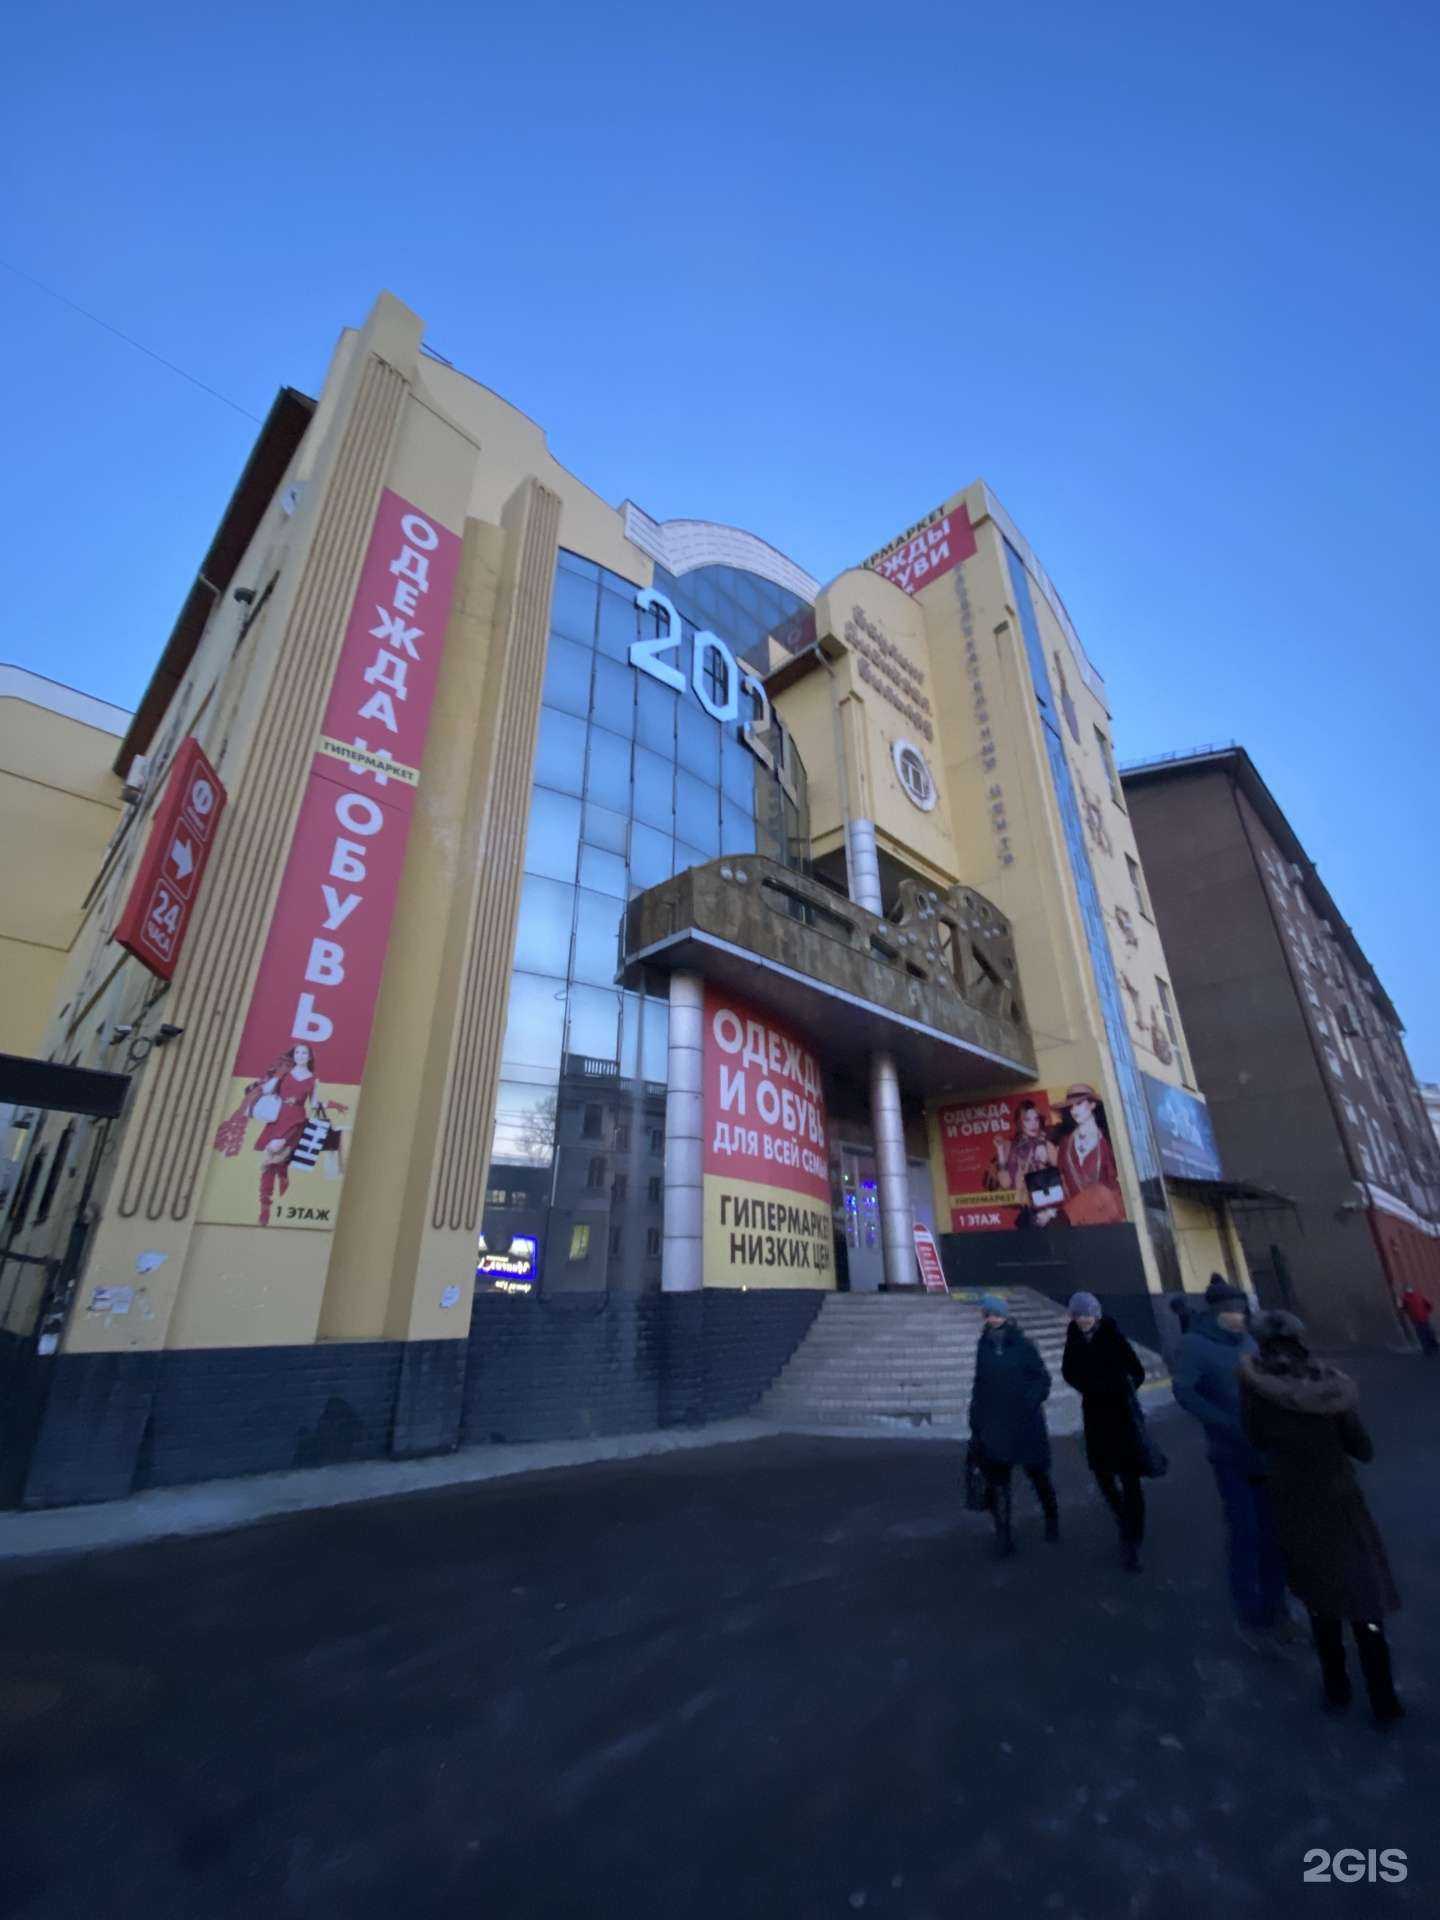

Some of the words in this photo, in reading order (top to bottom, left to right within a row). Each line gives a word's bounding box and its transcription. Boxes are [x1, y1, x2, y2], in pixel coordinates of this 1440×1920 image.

[858, 504, 945, 569] ЕРМАРКЕТ
[891, 541, 950, 587] УВИ
[357, 514, 439, 733] ОДЕЖДА
[324, 742, 415, 781] ГИПЕРМАРКЕТ
[152, 890, 178, 934] 24
[291, 793, 383, 1042] ОБУВЬ
[719, 1065, 746, 1116] И
[756, 1080, 825, 1148] ОБУВЬ
[943, 1103, 1010, 1125] ОДЕЖДА
[946, 1126, 957, 1138] И
[960, 1119, 1010, 1137] ОБУВЬ
[713, 1121, 758, 1156] ДЛЯ
[763, 1134, 800, 1168] ВСЕЙ
[277, 1206, 283, 1218] 1
[286, 1207, 330, 1221] ЭТАЖ
[720, 1195, 830, 1240] ГИПЕРМАРКЕ
[959, 1215, 965, 1227] 1
[967, 1212, 1001, 1227] ЭТАЖ
[730, 1233, 810, 1268] НИЗКИХ
